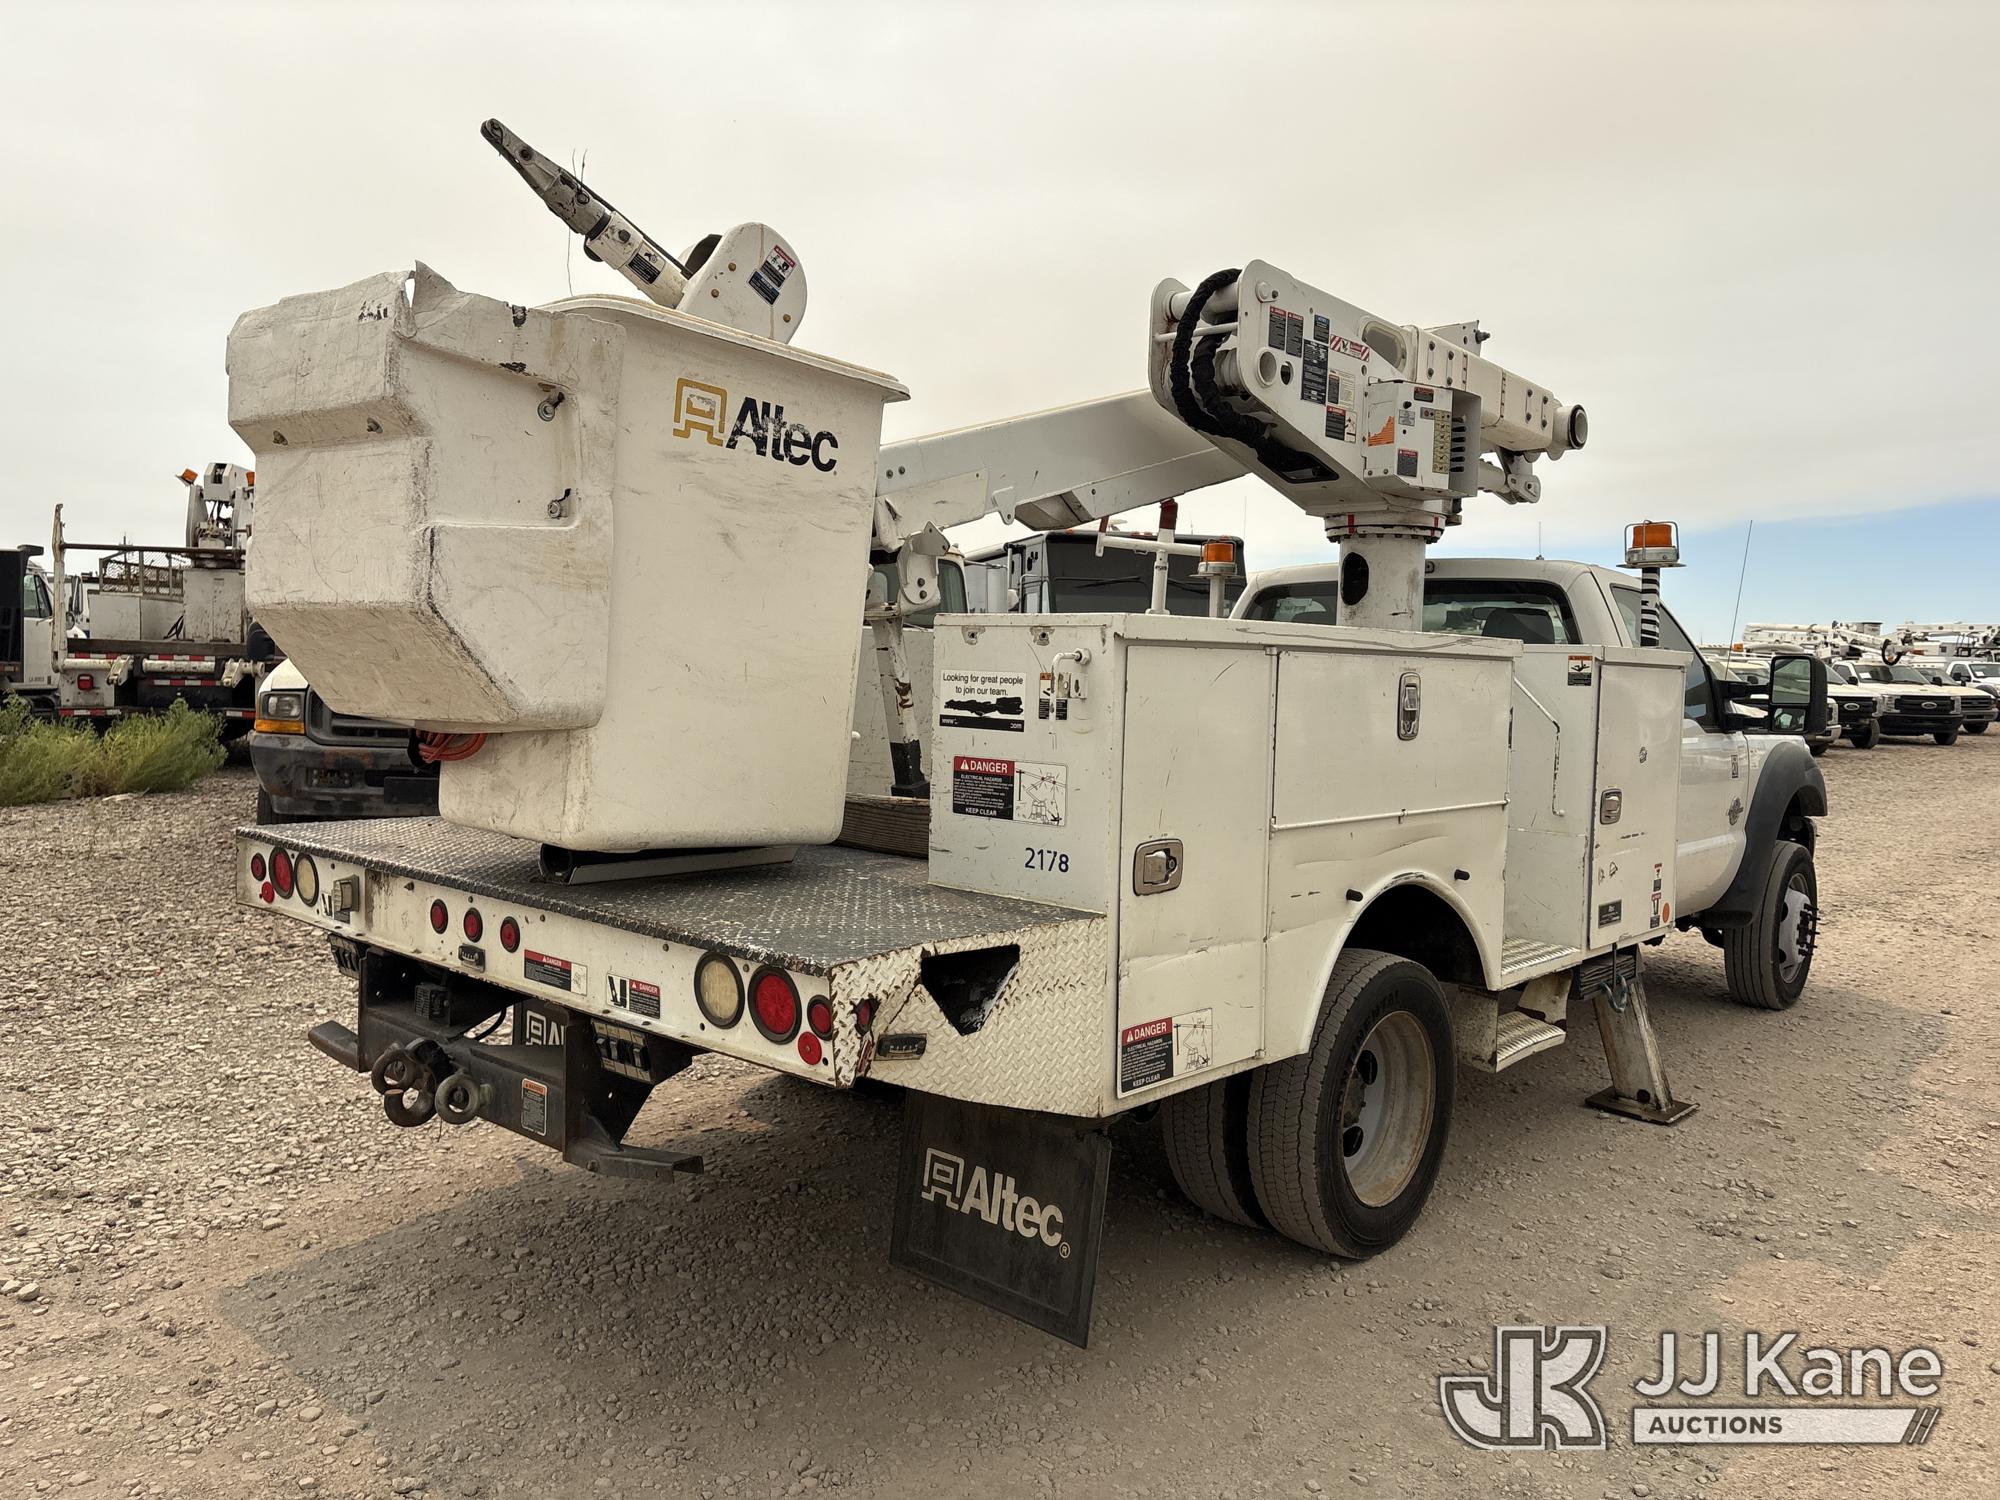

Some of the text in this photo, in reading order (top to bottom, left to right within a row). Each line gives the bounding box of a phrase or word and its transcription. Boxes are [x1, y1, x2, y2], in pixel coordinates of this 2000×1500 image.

[726, 396, 839, 472] Altec
[943, 673, 1023, 686] Looking for great people
[956, 686, 1008, 696] to join our team.
[970, 760, 1008, 774] DANGER
[1024, 847, 1069, 873] 2178
[639, 983, 658, 994] DANGER
[1134, 1021, 1167, 1040] DANGER
[1132, 1074, 1161, 1087] KEEP CLEAR
[960, 1165, 1064, 1247] Altec
